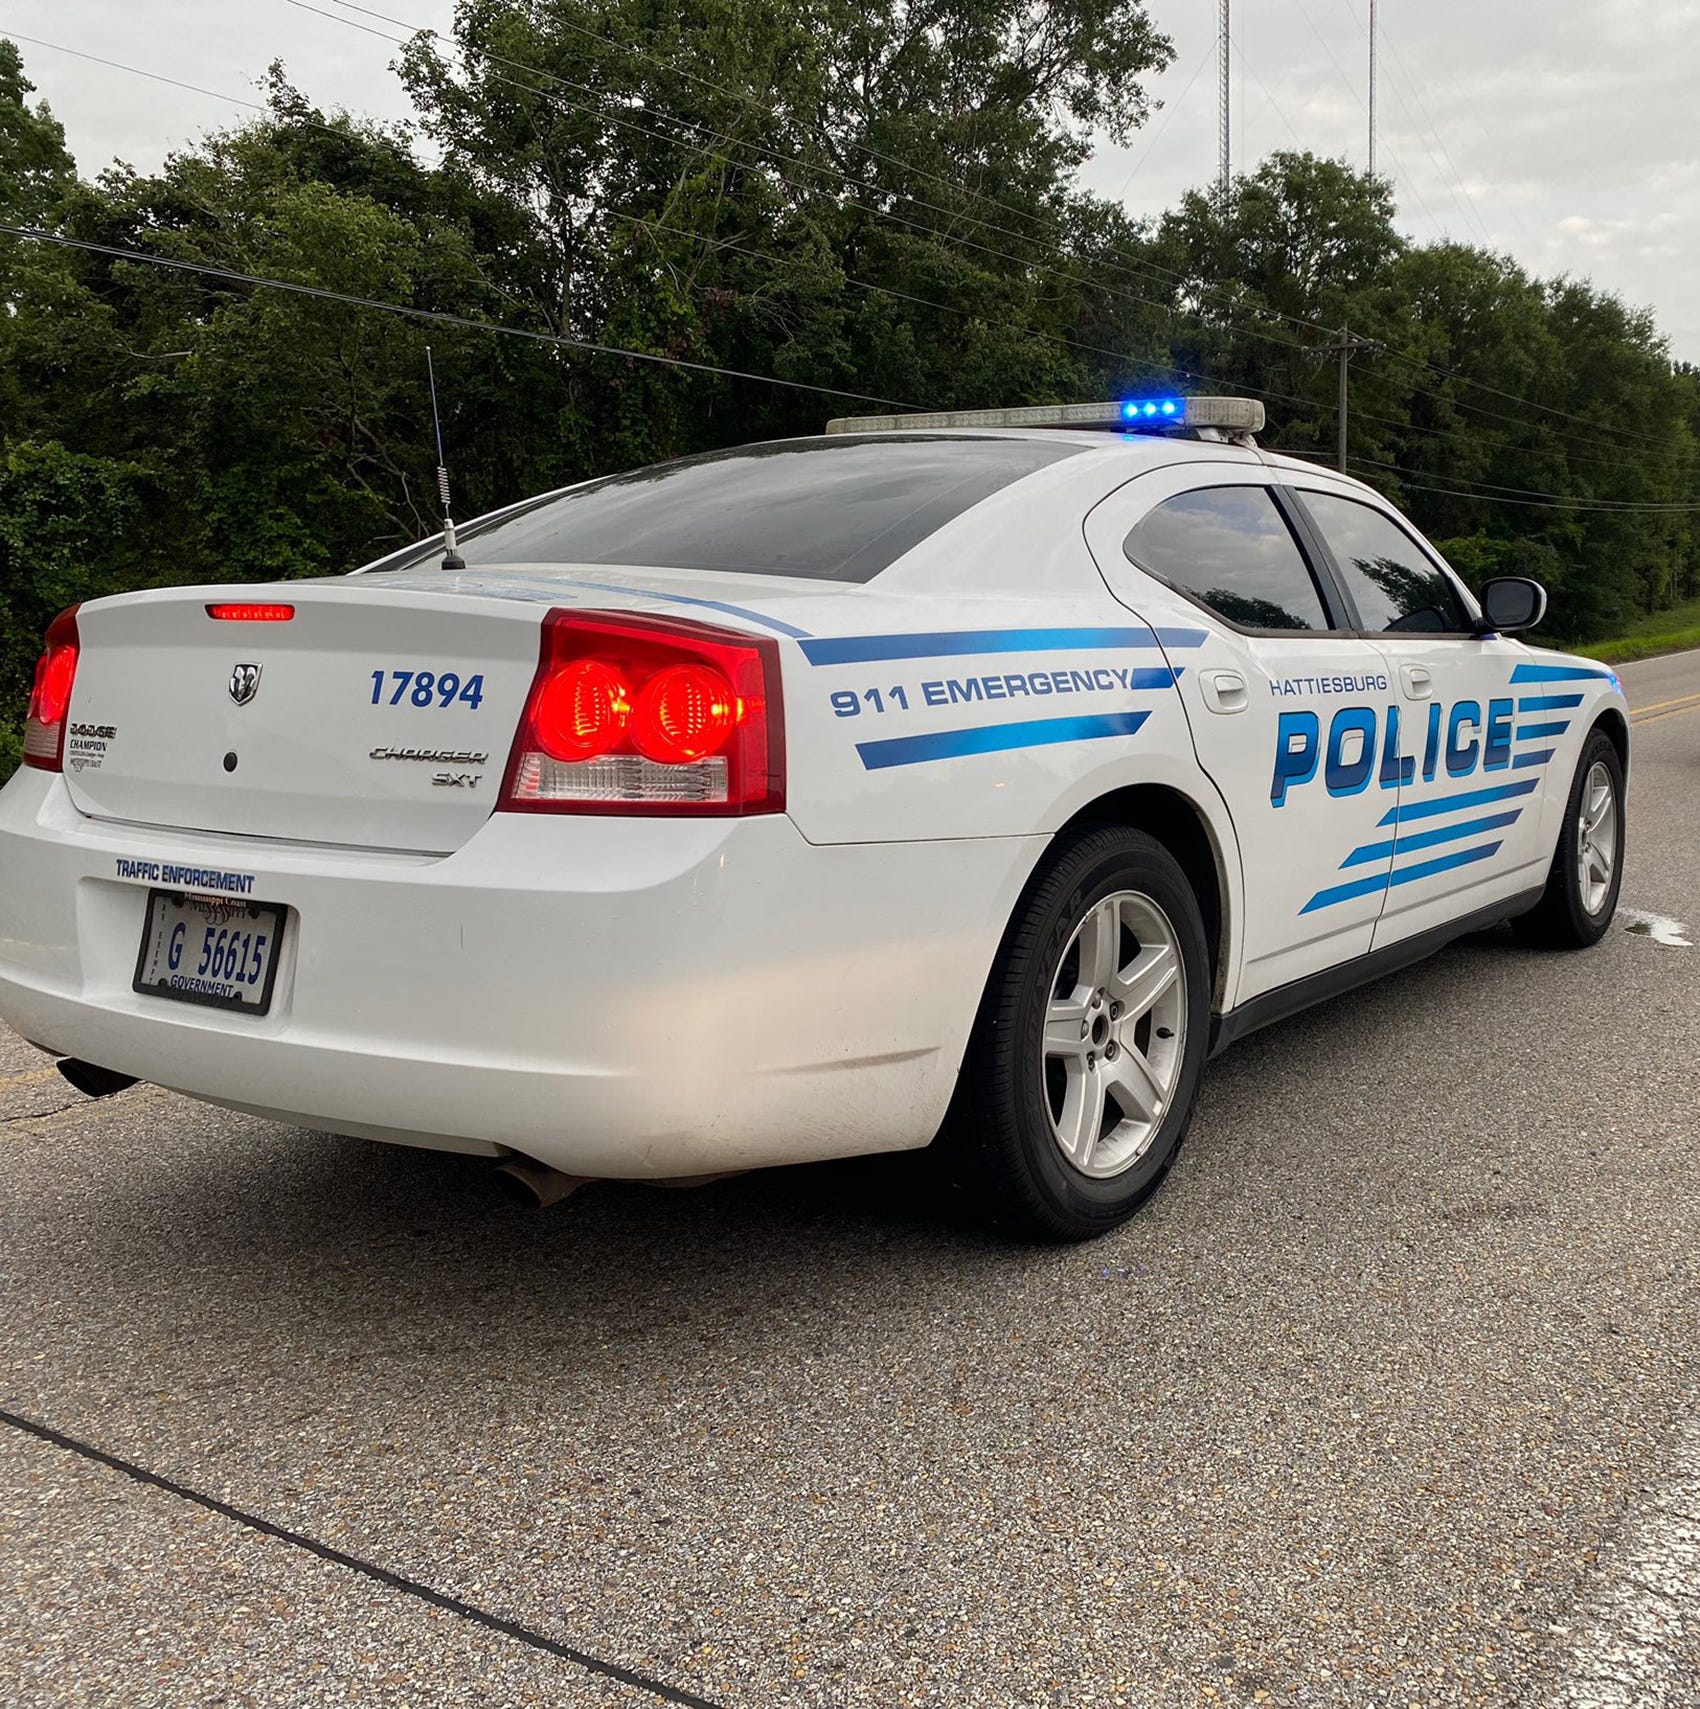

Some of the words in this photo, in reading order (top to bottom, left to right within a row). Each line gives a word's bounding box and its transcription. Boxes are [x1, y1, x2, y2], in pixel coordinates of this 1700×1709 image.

[370, 670, 484, 710] 17894
[830, 687, 909, 718] 911
[921, 669, 1132, 706] EMERGENCY
[1270, 675, 1387, 696] HATTIESBURG
[70, 723, 117, 739] DODGE
[70, 739, 107, 751] CHAMPION
[369, 747, 489, 764] CHARGER
[1270, 698, 1516, 809] POLICE
[432, 772, 482, 788] SXT
[116, 859, 159, 881] TRAFFIC
[161, 865, 255, 893] ENFORCEMENT
[225, 897, 247, 908] Coast
[168, 922, 186, 970] G
[197, 927, 266, 985] 56615
[170, 974, 234, 997] GOVERNMENT
